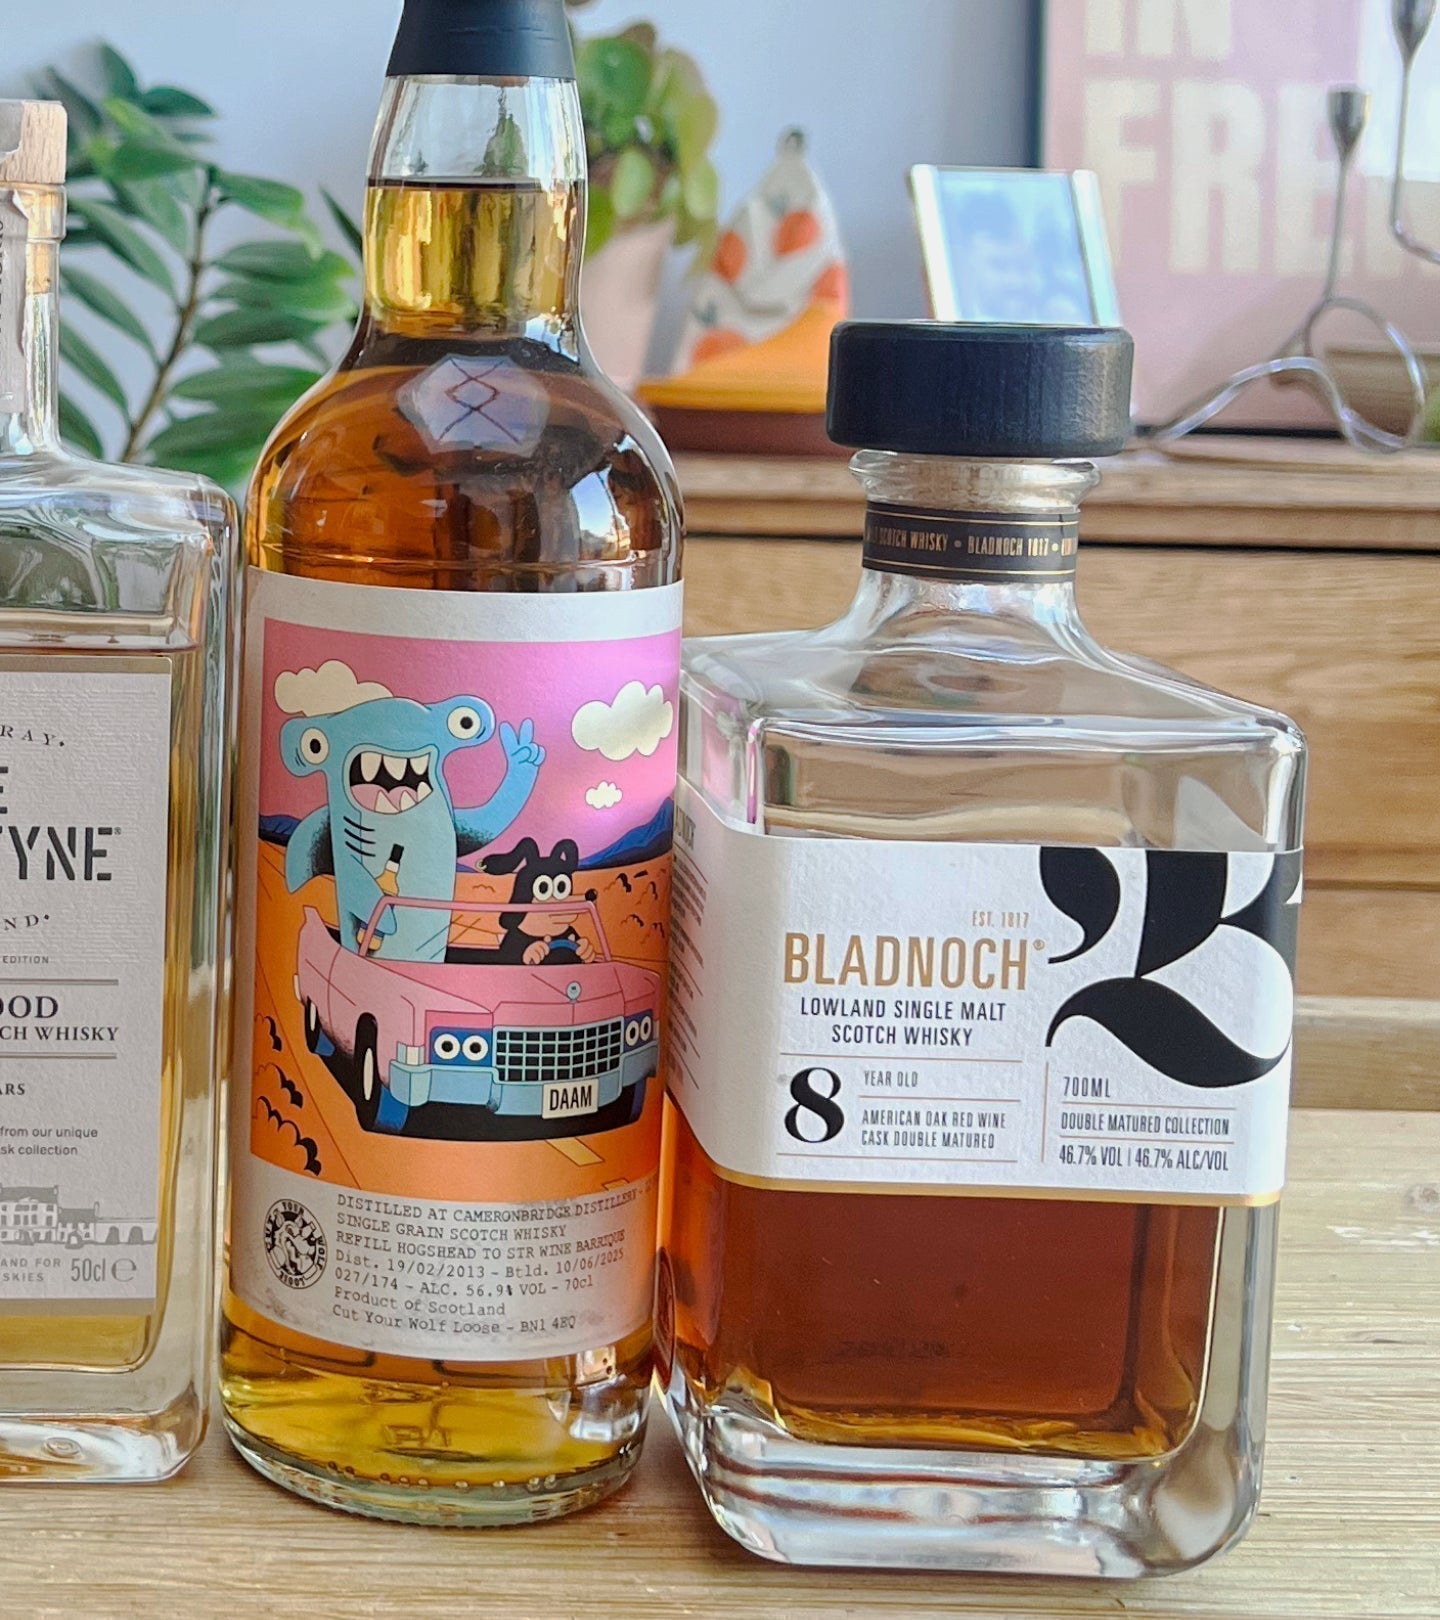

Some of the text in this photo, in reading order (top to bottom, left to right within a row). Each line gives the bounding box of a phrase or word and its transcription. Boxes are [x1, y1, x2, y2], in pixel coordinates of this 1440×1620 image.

[910, 531, 948, 551] WHISKY
[967, 536, 1022, 556] BLADNOCH
[1001, 912, 1030, 929] 1817
[2, 954, 50, 965] EDITION
[801, 997, 1006, 1021] LOWLAND SINGLE MALT
[35, 1025, 120, 1042] WHISKY
[831, 1025, 973, 1047] SCOTCH WHISKY
[863, 1070, 918, 1088] YEAR OLD
[1063, 1076, 1111, 1098] 700ML
[549, 1085, 592, 1111] DAAM
[784, 1067, 845, 1143] 8
[862, 1109, 1006, 1129] AMERICAN OAK RED WINE
[1061, 1112, 1230, 1136] DOUBLE MATURED COLLECTION
[0, 1126, 29, 1138] from
[32, 1129, 53, 1139] our
[55, 1127, 98, 1140] unique
[861, 1130, 995, 1149] CASK DOUBLE MATURED
[18, 1144, 78, 1157] collection
[1059, 1144, 1123, 1167] 46.7% VOL
[1135, 1148, 1229, 1171] 46.7% ALC/VOL
[336, 1193, 423, 1219] DISTILLED
[427, 1208, 448, 1221] AT
[453, 1206, 572, 1222] CAMERONBRIDGE
[336, 1212, 567, 1241] SINGLE GRAIN SCOTCH WHISKY
[336, 1230, 391, 1253] REFILL
[397, 1241, 476, 1260] HOGSHEAD
[482, 1248, 501, 1260] TO
[506, 1247, 535, 1259] STR
[539, 1242, 572, 1257] WINE
[35, 1258, 61, 1268] FOR
[70, 1258, 106, 1281] 50cl
[335, 1248, 624, 1279] Dist. 19/02/2013 Btld. 10/06/2025
[335, 1267, 398, 1290] 027/174
[420, 1282, 457, 1296] ALC.
[519, 1282, 547, 1296] VOL
[334, 1286, 505, 1316] Product of Scotland
[332, 1304, 359, 1321] Cut
[365, 1311, 402, 1328] Your
[408, 1318, 447, 1332] Wolf
[453, 1322, 500, 1334] Loose
[520, 1320, 545, 1333] BN1
